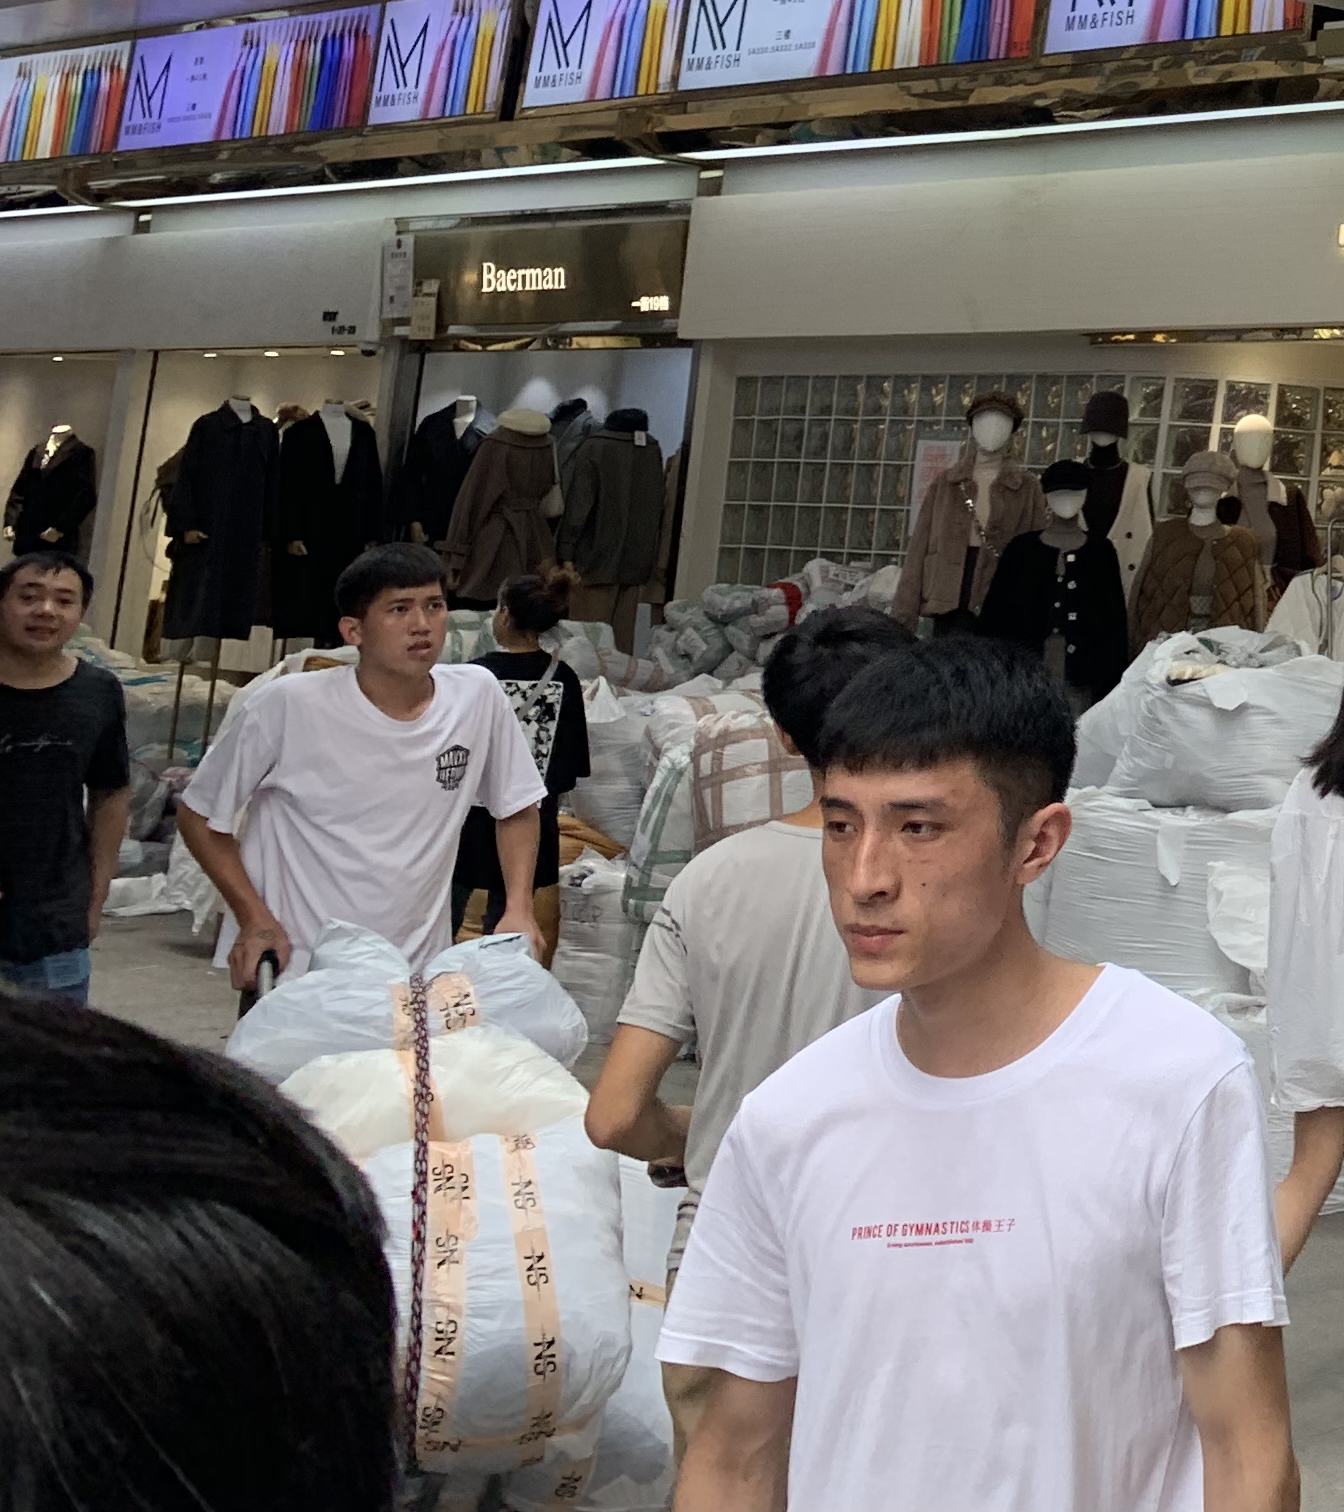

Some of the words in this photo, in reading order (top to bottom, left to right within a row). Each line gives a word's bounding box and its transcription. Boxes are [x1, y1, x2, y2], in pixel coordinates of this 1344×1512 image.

[1065, 9, 1135, 32] MM&FISH
[686, 53, 742, 73] MM&FISH
[533, 72, 583, 90] MM&FISH
[374, 91, 419, 109] MM&FISH
[481, 261, 567, 294] Baerman
[851, 1224, 883, 1241] PRINCE
[886, 1223, 899, 1238] OF
[901, 1219, 970, 1237] GYMNASTICS
